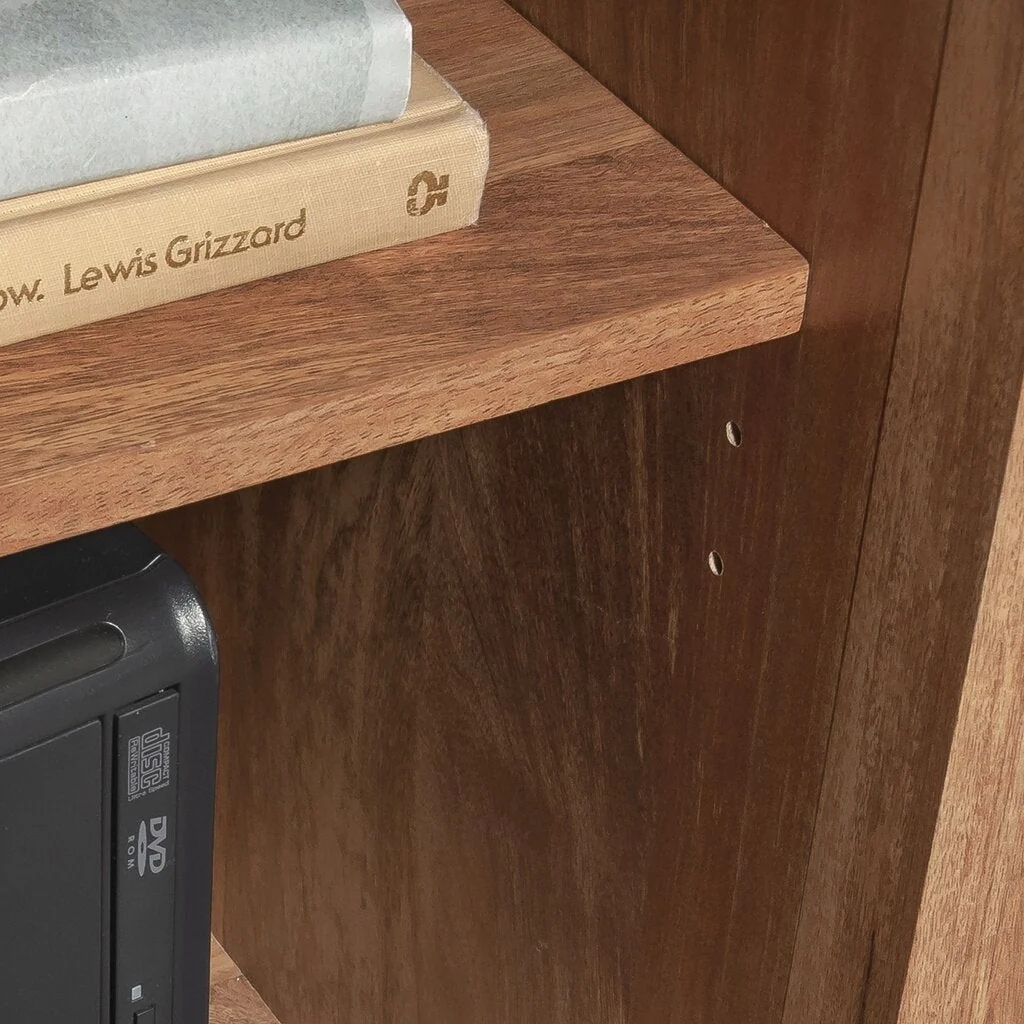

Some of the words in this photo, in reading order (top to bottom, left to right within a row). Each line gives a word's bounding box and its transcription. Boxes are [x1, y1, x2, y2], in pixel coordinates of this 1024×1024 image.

[63, 246, 158, 294] Lewis
[164, 207, 307, 269] Grizzard
[162, 740, 170, 781] COMPACT
[127, 835, 135, 870] ROM
[147, 815, 167, 874] DVD
